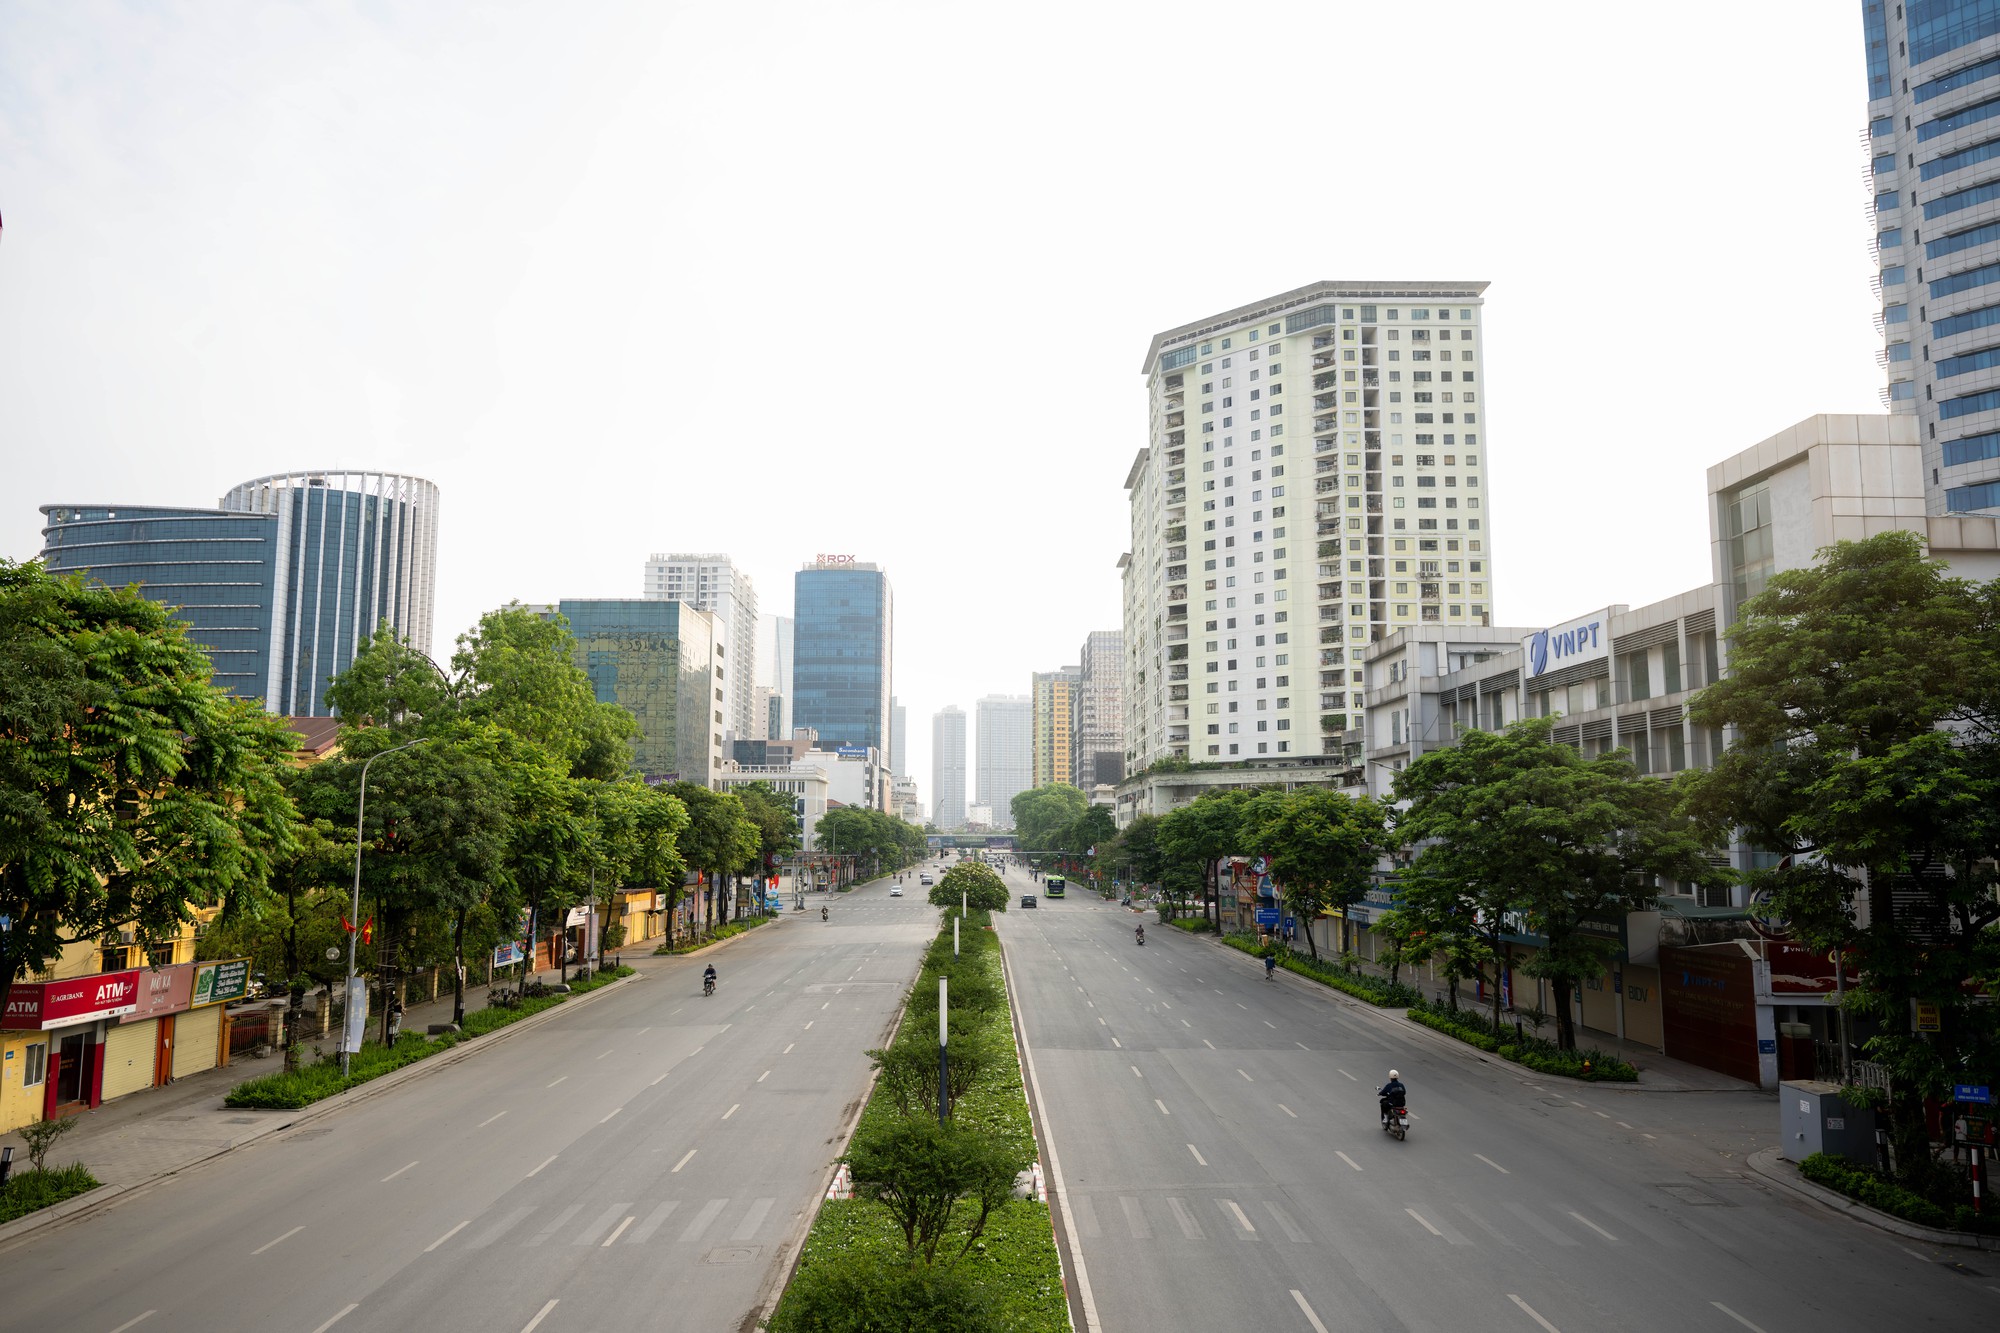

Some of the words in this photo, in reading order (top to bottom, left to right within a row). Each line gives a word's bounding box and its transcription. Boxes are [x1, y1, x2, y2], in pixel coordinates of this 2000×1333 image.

[827, 554, 855, 563] ROX
[1552, 621, 1599, 659] VNPT
[1503, 910, 1529, 935] BIDV
[55, 992, 84, 1002] AGRIBANK
[96, 982, 124, 1001] ATM
[1628, 985, 1648, 1002] BIDV
[7, 1002, 38, 1013] ATM
